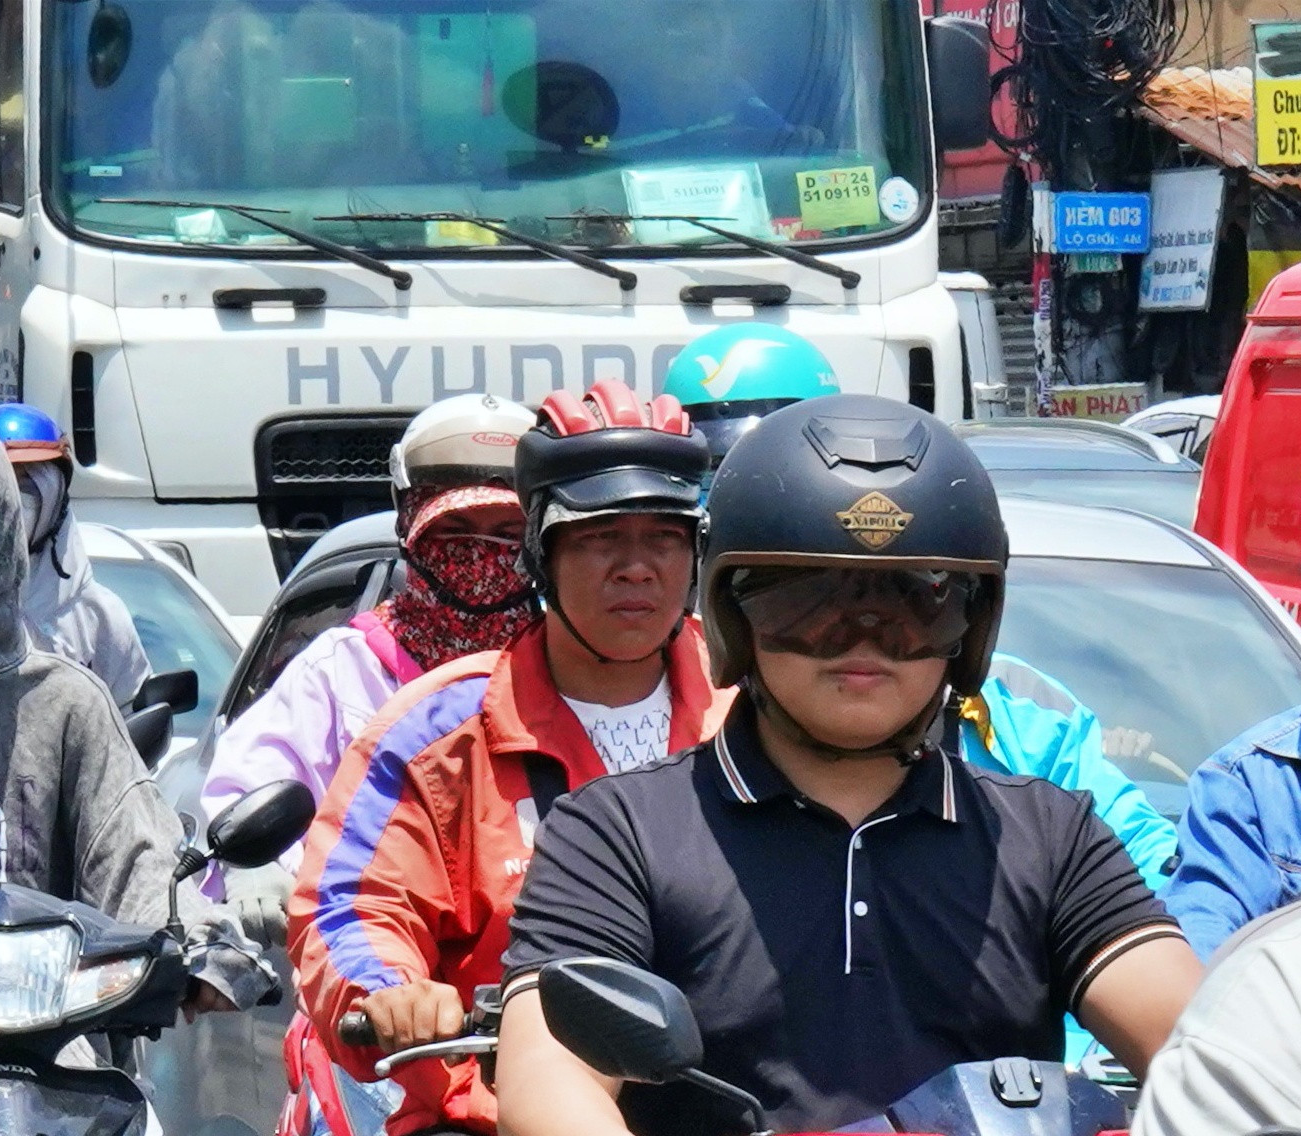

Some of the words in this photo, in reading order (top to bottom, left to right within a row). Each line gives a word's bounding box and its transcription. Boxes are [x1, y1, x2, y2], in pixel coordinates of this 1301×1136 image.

[1276, 127, 1301, 156] ĐT:
[805, 177, 816, 188] D
[851, 172, 869, 184] 24
[852, 516, 896, 528] NAPOLI
